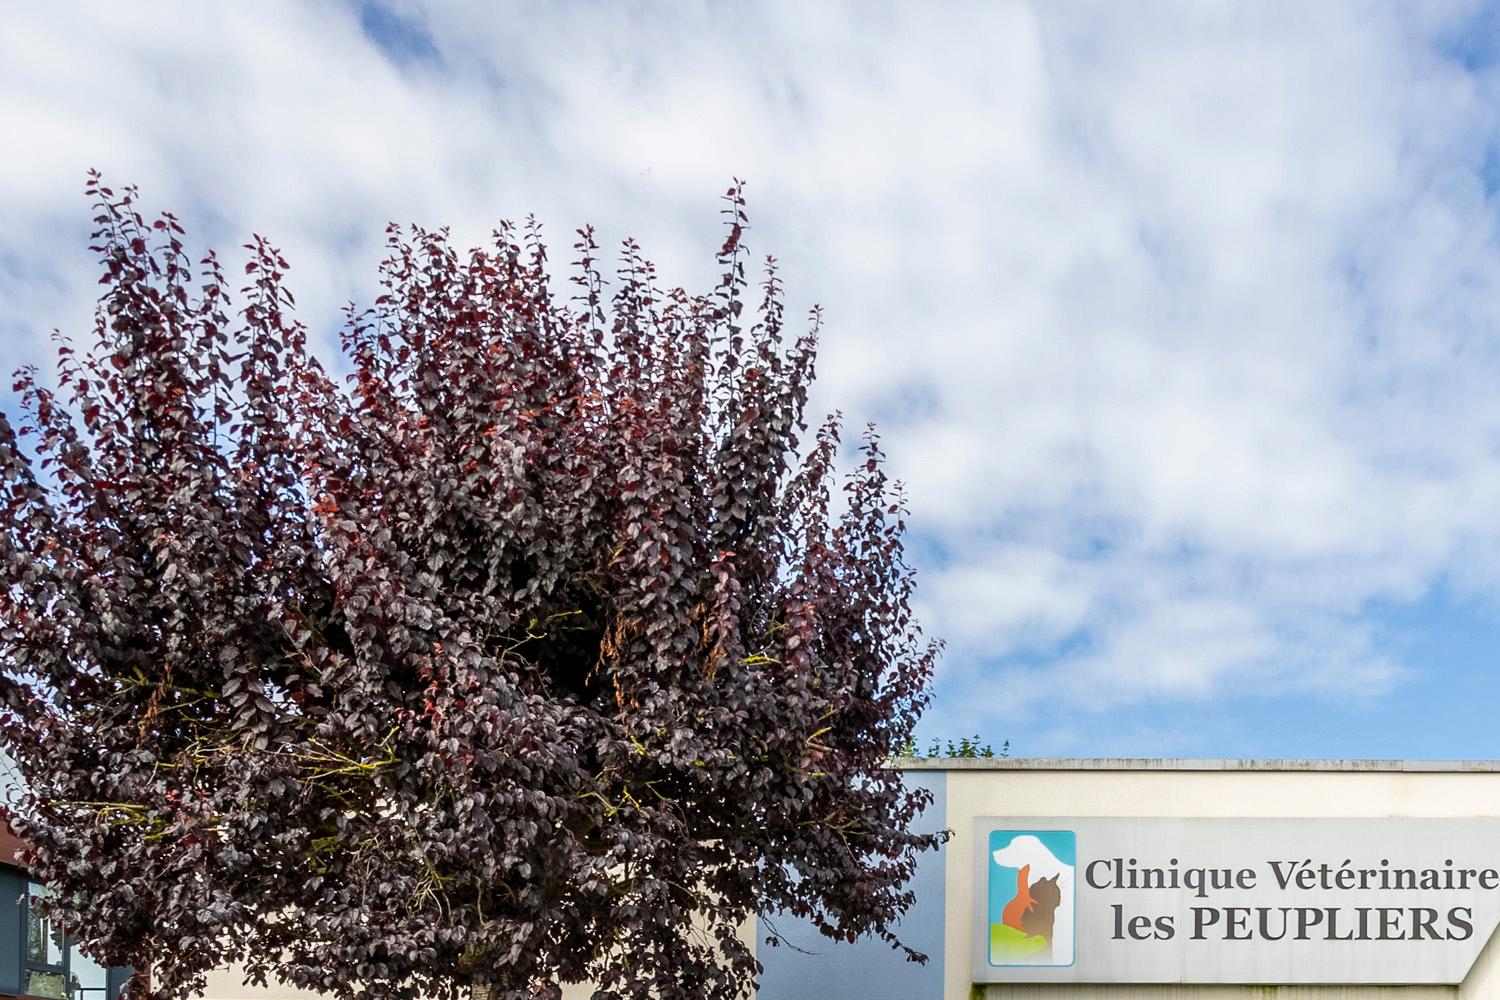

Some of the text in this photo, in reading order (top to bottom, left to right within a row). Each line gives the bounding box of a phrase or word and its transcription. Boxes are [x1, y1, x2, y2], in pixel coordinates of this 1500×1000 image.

[1085, 858, 1500, 898] Clinique Vétérinaire
[1110, 904, 1474, 941] les PEUPLIERS
